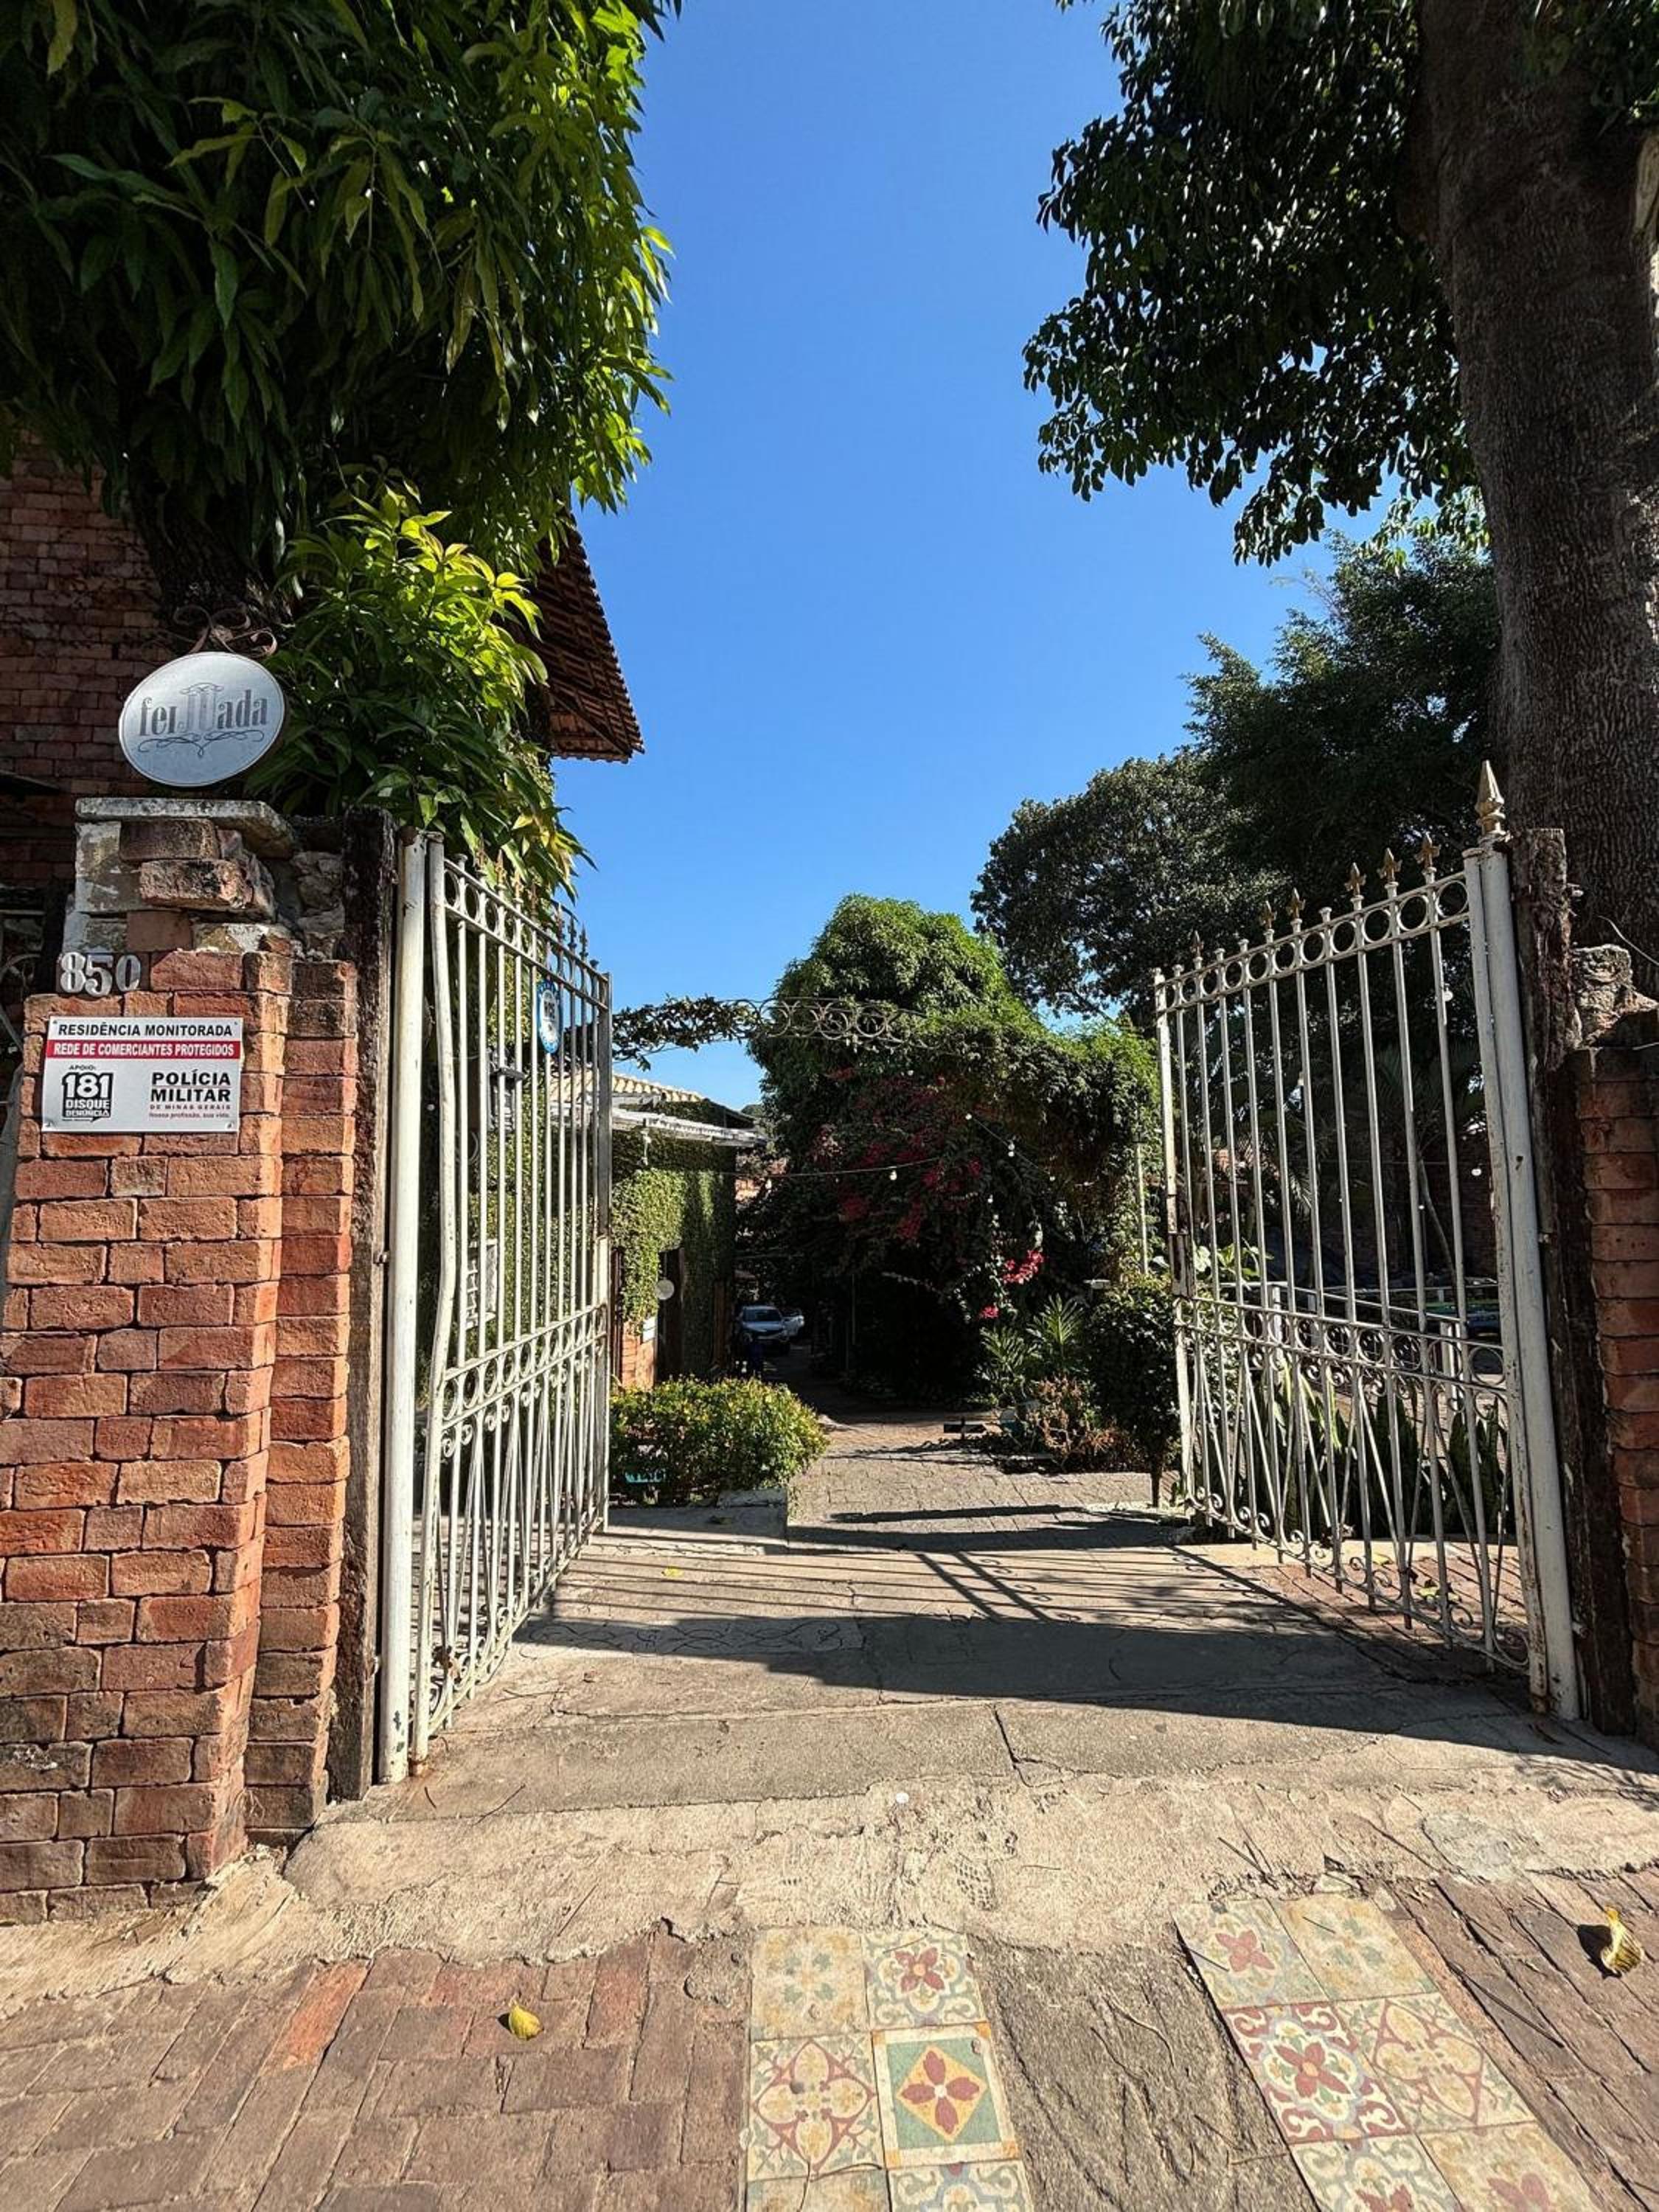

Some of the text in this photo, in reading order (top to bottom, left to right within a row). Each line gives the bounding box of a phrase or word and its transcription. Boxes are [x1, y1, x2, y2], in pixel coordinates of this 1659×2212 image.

[60, 952, 141, 998] 850
[58, 1022, 232, 1036] RESIDÊNCIA MONITORADA
[54, 1043, 234, 1057] REDE DE COMERCIANTES PROTEGIDOS
[152, 1068, 231, 1085] POLÍCIA
[65, 1074, 110, 1099] 181
[150, 1089, 231, 1102] MILITAR
[66, 1099, 110, 1109] DISQUE
